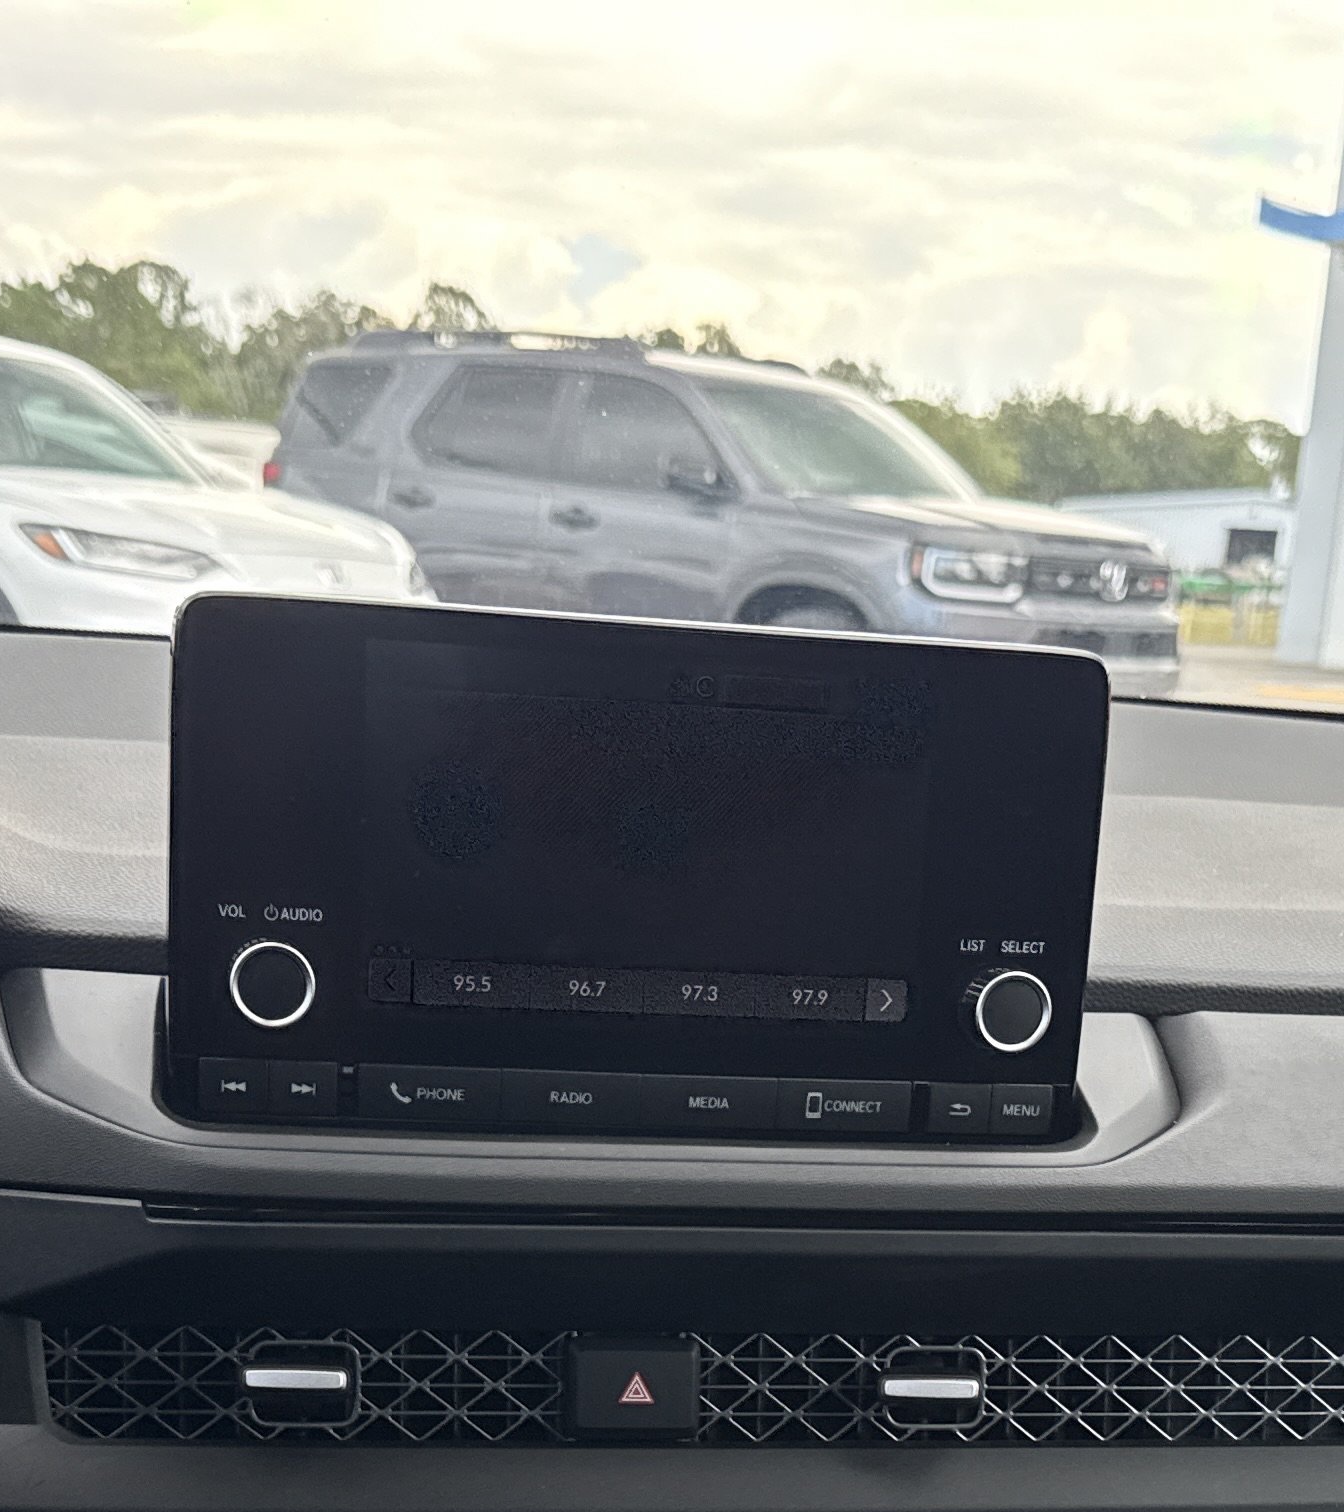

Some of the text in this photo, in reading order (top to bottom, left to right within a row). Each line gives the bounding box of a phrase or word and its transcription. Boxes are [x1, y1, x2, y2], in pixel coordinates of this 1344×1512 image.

[218, 904, 246, 919] VOL
[280, 907, 324, 922] AUDIO
[960, 939, 986, 953] LIST
[1001, 940, 1046, 955] SELECT
[453, 975, 492, 993] 95.5
[568, 980, 607, 998] 96.7
[681, 984, 719, 1003] 97.3
[792, 989, 828, 1006] 97.9
[416, 1086, 466, 1102] PHONE
[550, 1090, 593, 1105] RADIO
[688, 1096, 729, 1110] MEDIA
[824, 1099, 882, 1114] CONNECT
[1002, 1103, 1040, 1118] MENU
